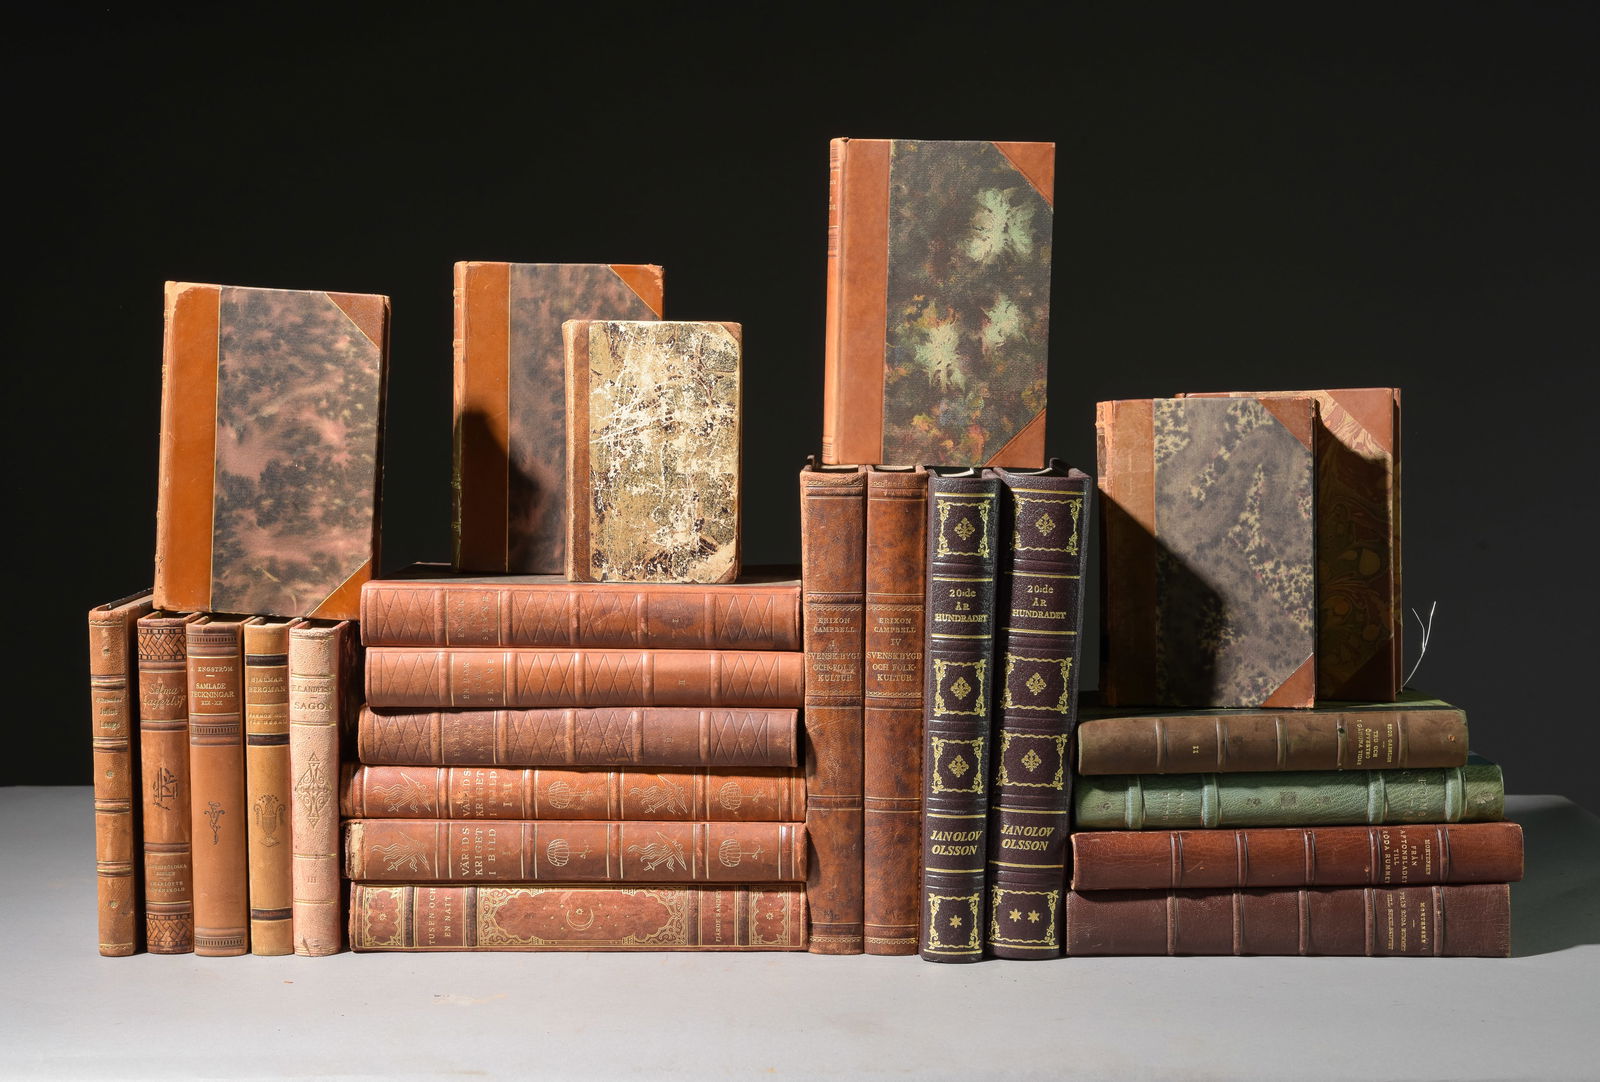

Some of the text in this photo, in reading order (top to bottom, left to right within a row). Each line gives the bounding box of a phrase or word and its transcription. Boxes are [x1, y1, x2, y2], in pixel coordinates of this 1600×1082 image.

[949, 588, 976, 597] 20:de
[1027, 584, 1054, 593] 20:de
[954, 601, 970, 610] ÅR
[1032, 597, 1047, 607] ÅR
[890, 638, 902, 646] IV
[872, 663, 889, 671] OCH
[818, 674, 853, 682] KULTUR
[149, 682, 178, 695] Selma
[196, 682, 226, 690] SAMLADE
[143, 694, 186, 711] Lagerlöf
[932, 844, 978, 856] OLSSON
[1001, 838, 1049, 851] OLSSON
[475, 828, 483, 876] KRIGET
[1411, 845, 1419, 866] FRÅN
[428, 913, 436, 945] TUSEN
[444, 925, 451, 937] EN
